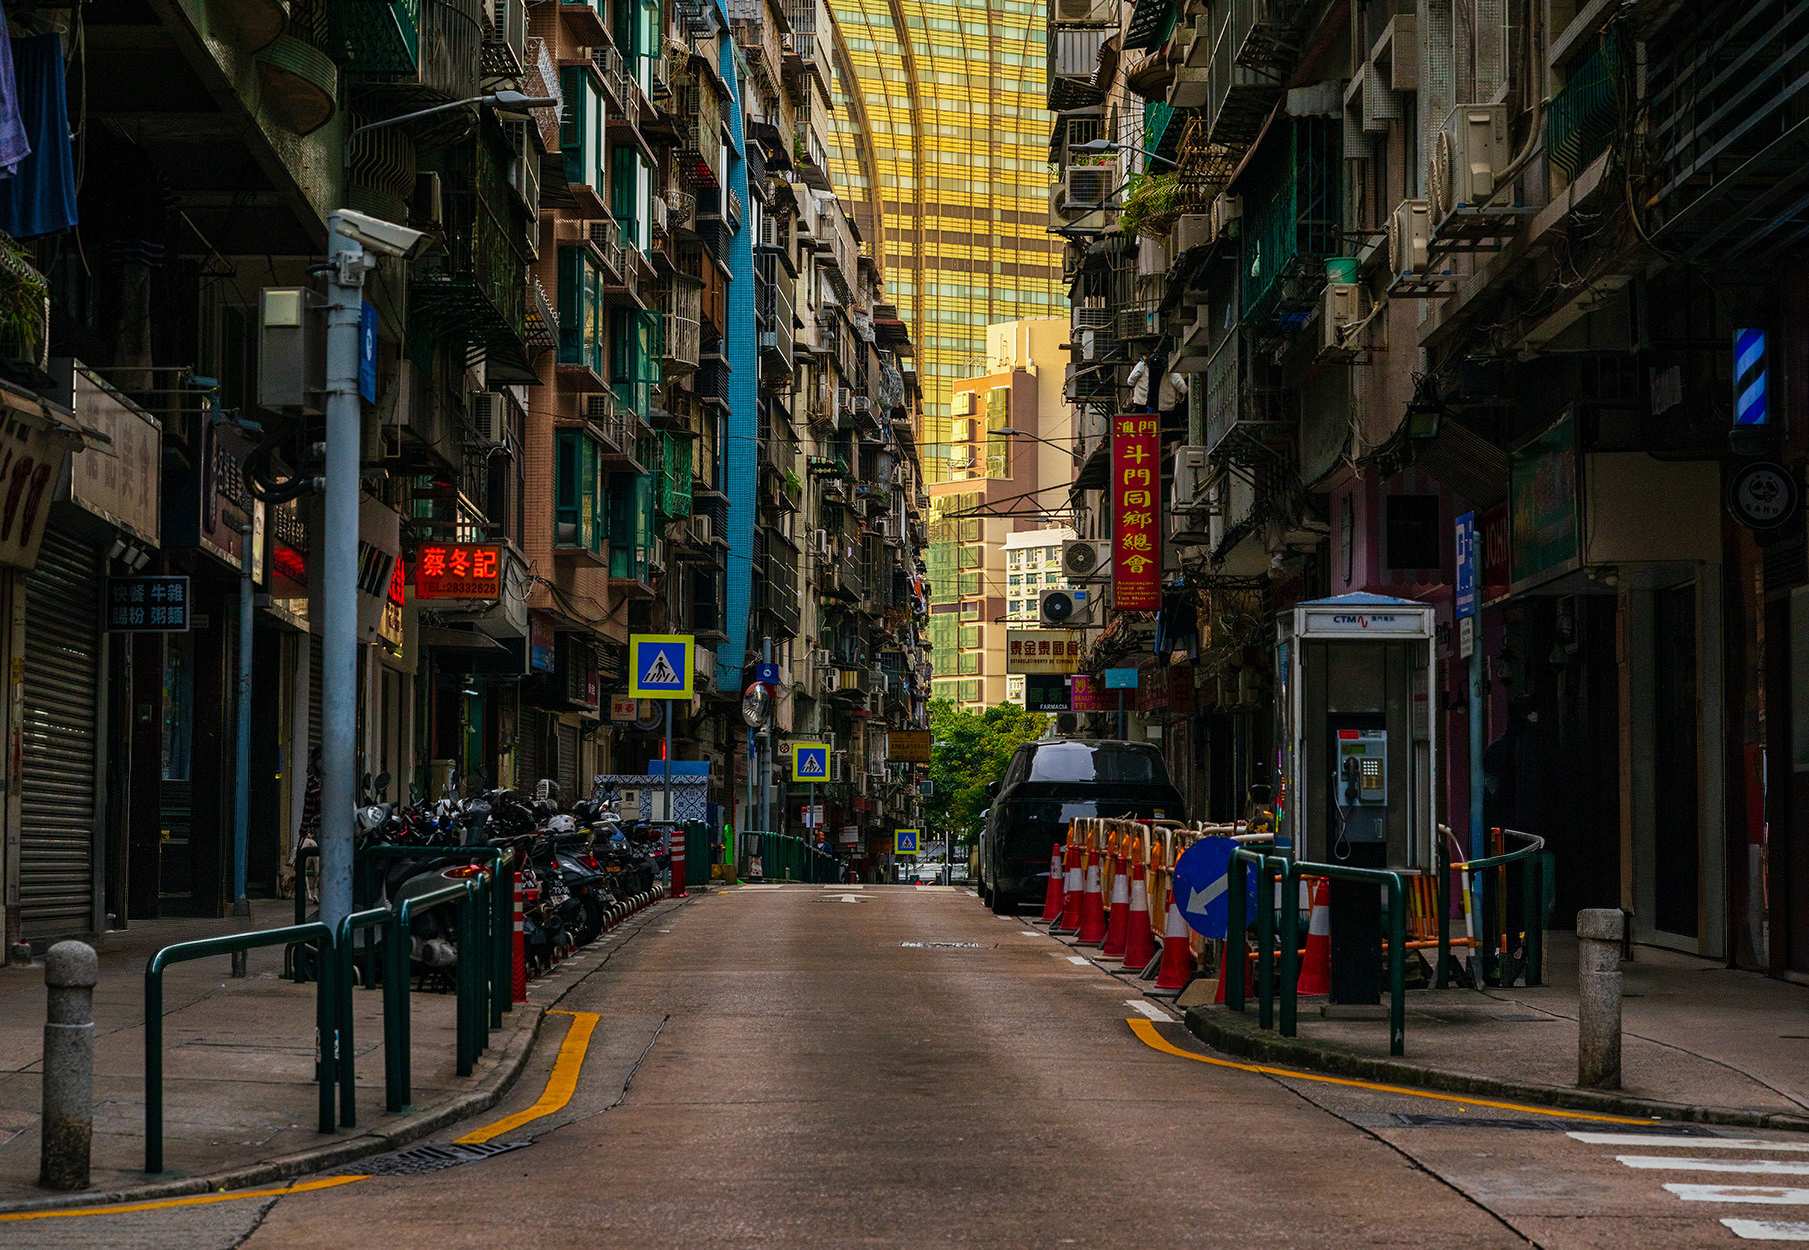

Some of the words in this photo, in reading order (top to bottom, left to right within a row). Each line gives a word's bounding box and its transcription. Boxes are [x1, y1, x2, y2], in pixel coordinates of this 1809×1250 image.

[1116, 420, 1157, 438] 澳門
[1121, 444, 1154, 574] 斗門同鄉總會
[423, 547, 497, 579] 蔡冬記
[1333, 615, 1356, 623] CTM
